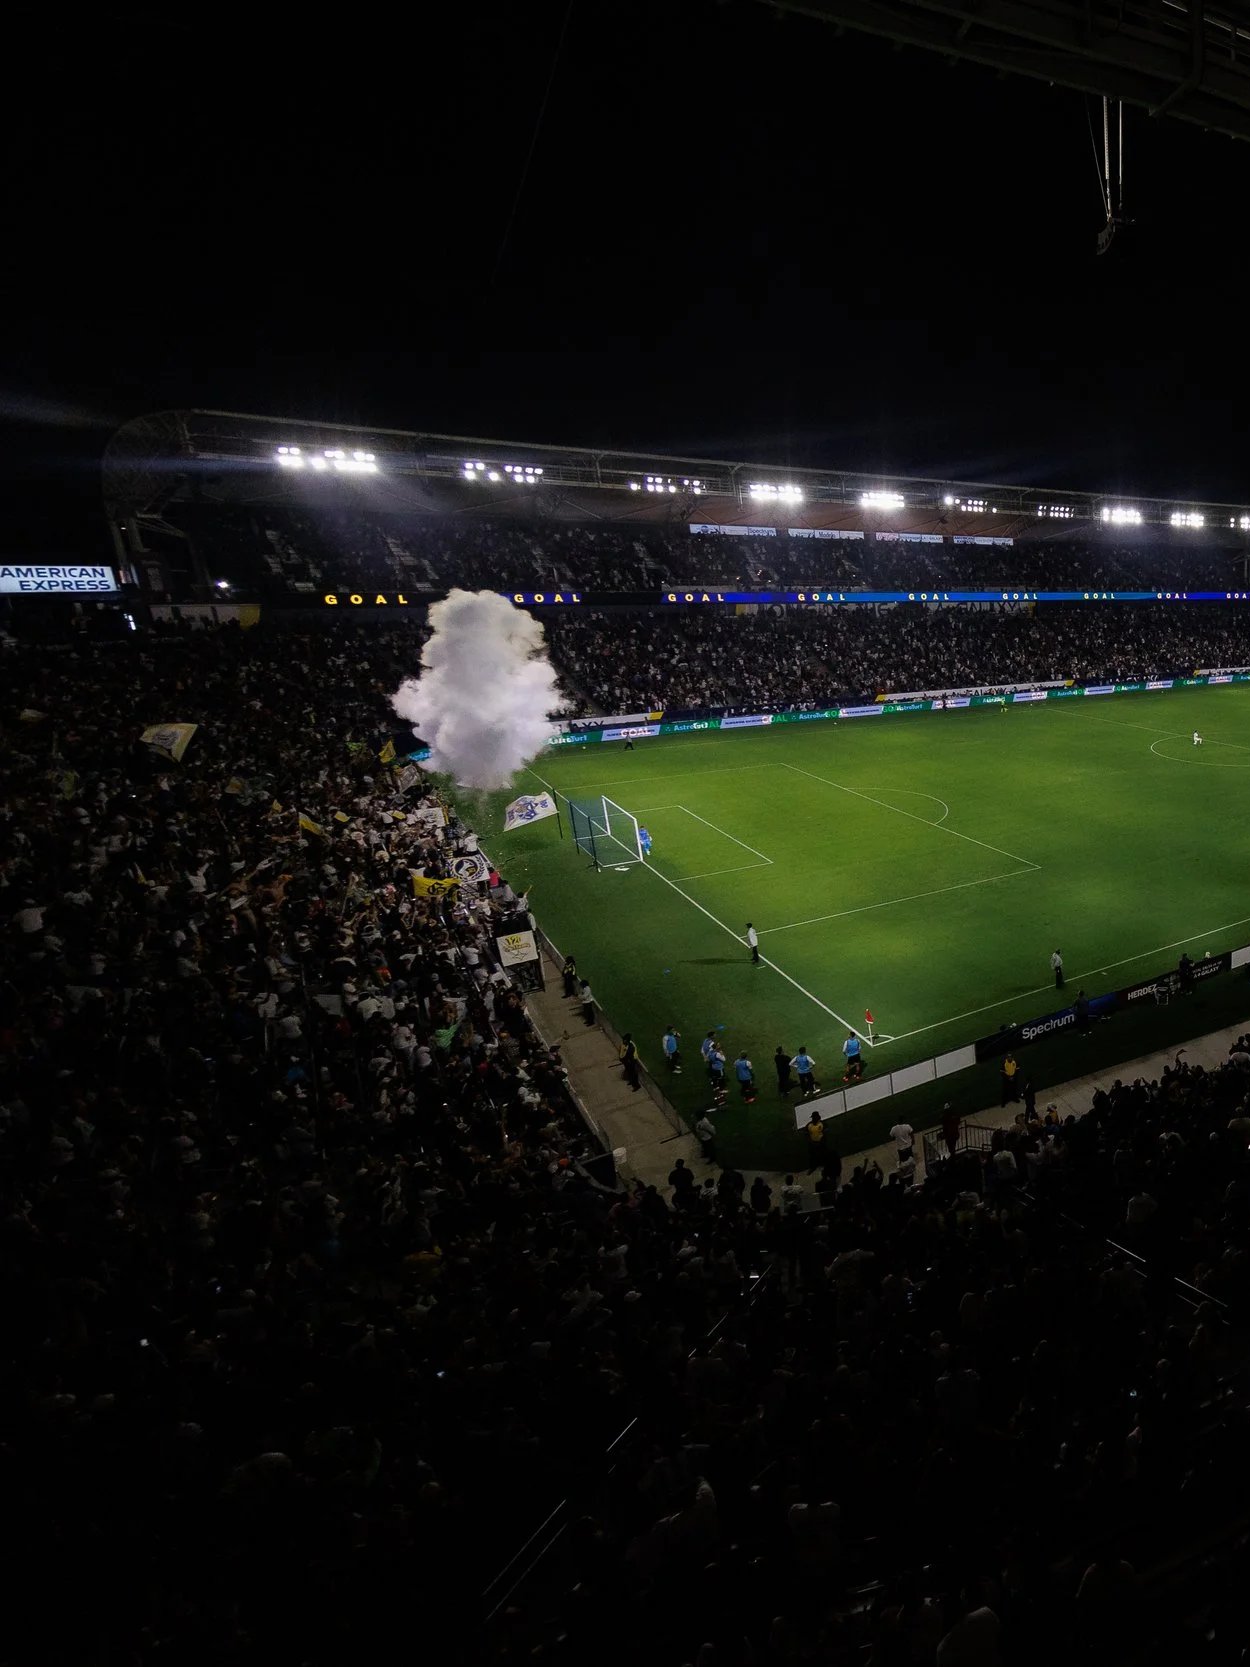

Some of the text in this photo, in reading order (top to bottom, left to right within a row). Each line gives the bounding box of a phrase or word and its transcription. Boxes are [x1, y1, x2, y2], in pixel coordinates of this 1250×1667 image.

[0, 567, 105, 578] AMERICAN
[20, 580, 111, 591] EXPRESS
[325, 595, 408, 605] GOAL
[513, 594, 581, 603] GOAL
[668, 594, 725, 602] GOAL
[1127, 983, 1158, 1001] HERDEZ
[1021, 1012, 1076, 1042] Spectrum
